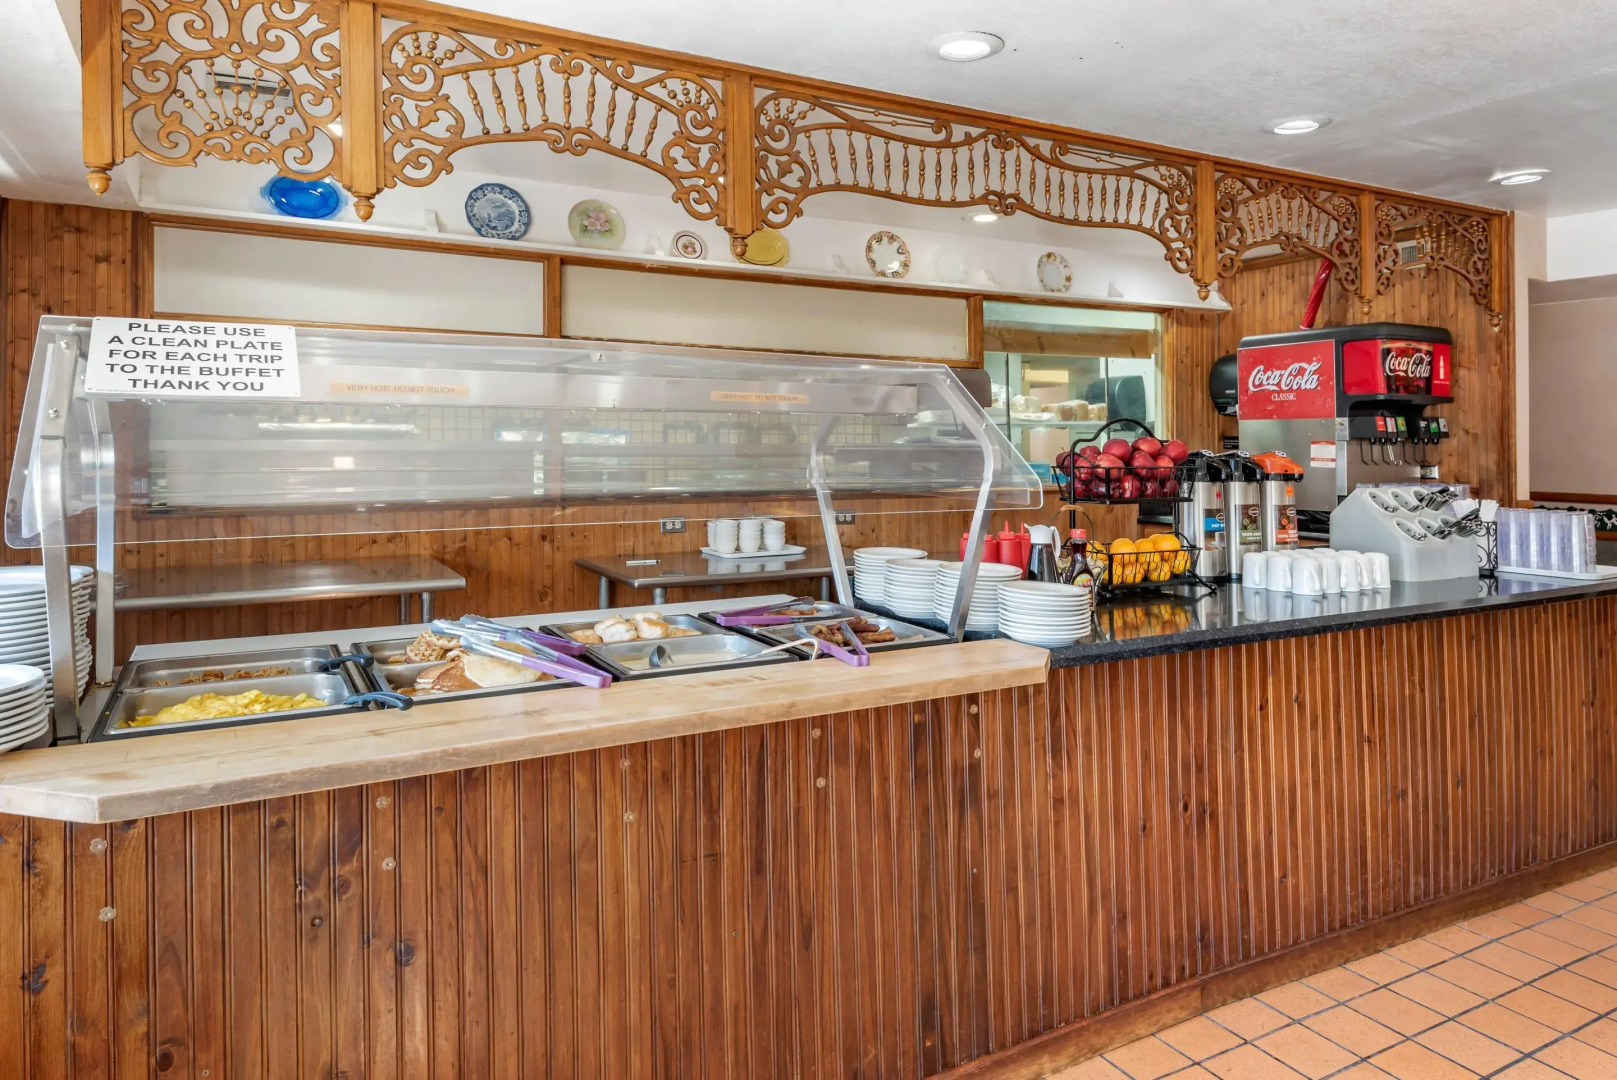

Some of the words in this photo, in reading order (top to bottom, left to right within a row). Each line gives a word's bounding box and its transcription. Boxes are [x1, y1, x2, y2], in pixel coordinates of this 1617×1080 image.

[128, 322, 216, 335] PLEASE
[224, 327, 266, 337] USE
[107, 335, 124, 345] A
[131, 336, 207, 348] CLEAN
[215, 340, 283, 351] PLATE
[108, 349, 158, 360] FOR
[165, 351, 227, 363] EACH
[234, 353, 283, 364] TRIP
[105, 363, 138, 374] TO
[145, 364, 191, 376] THE
[199, 366, 285, 378] BUFFET
[1385, 351, 1433, 378] Coca-Cola
[1248, 361, 1323, 392] Coca-Cola
[128, 378, 211, 391] THANK
[216, 381, 264, 392] YOU
[346, 384, 369, 392] VERY
[394, 385, 406, 393] DO
[1271, 392, 1297, 401] CLASSIC
